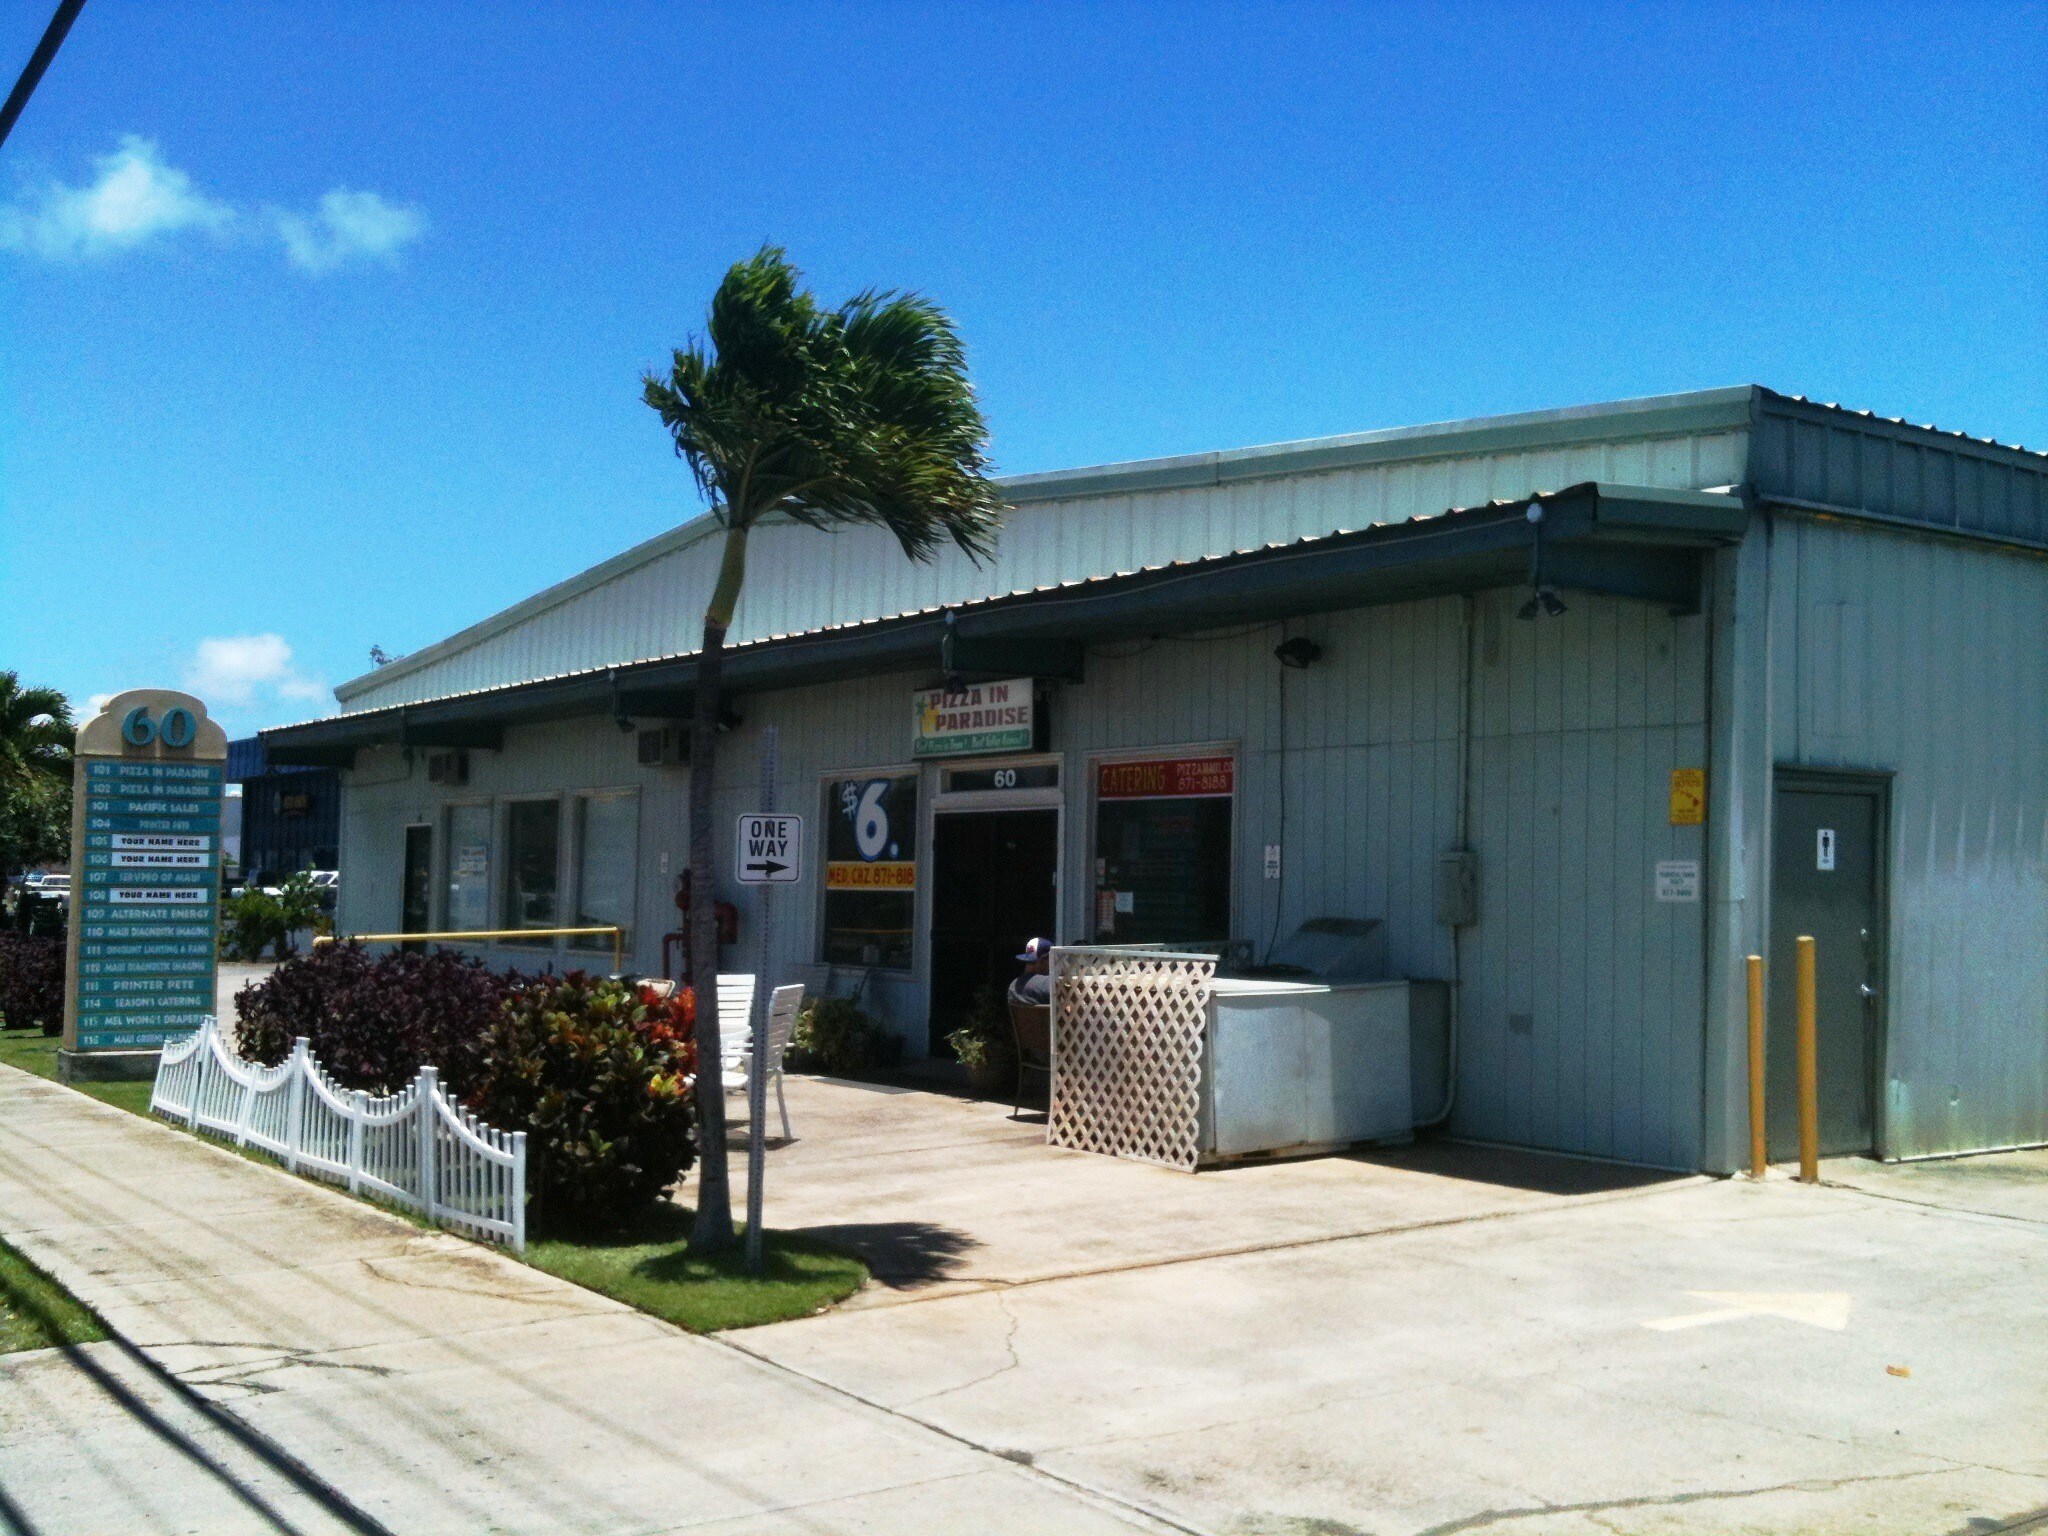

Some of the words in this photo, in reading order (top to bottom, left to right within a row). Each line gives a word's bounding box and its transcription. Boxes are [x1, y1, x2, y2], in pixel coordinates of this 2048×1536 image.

[930, 688, 982, 710] PIZZA
[989, 685, 1009, 703] IN
[935, 705, 1028, 732] PARADISE
[122, 706, 196, 748] 60
[120, 765, 149, 776] PIZZA
[152, 767, 163, 776] IN
[165, 767, 209, 778] PARADISE
[994, 769, 1017, 788] 60
[1101, 765, 1166, 793] CATERING
[1178, 775, 1228, 791] 871-8188
[120, 784, 149, 794] PIZZA
[152, 785, 163, 794] IN
[166, 785, 210, 796] PARADISE
[128, 803, 167, 812] PACIFIC
[170, 804, 199, 813] SALES
[751, 820, 788, 838] ONE
[121, 838, 145, 846] YOUR
[147, 838, 174, 846] NAME
[177, 838, 200, 847] HERE
[749, 839, 788, 857] WAY
[121, 855, 145, 863] YOUR
[147, 855, 174, 863] NAME
[177, 856, 200, 864] HERE
[119, 891, 143, 899] YOUR
[146, 891, 172, 899] NAME
[175, 891, 199, 899] HERE
[111, 909, 168, 919] ALTERNATE
[171, 909, 209, 919] ENERGY
[113, 980, 164, 990] PRINTER
[166, 980, 194, 989] PETE
[157, 996, 201, 1006] CATERING
[104, 1015, 122, 1026] MEL
